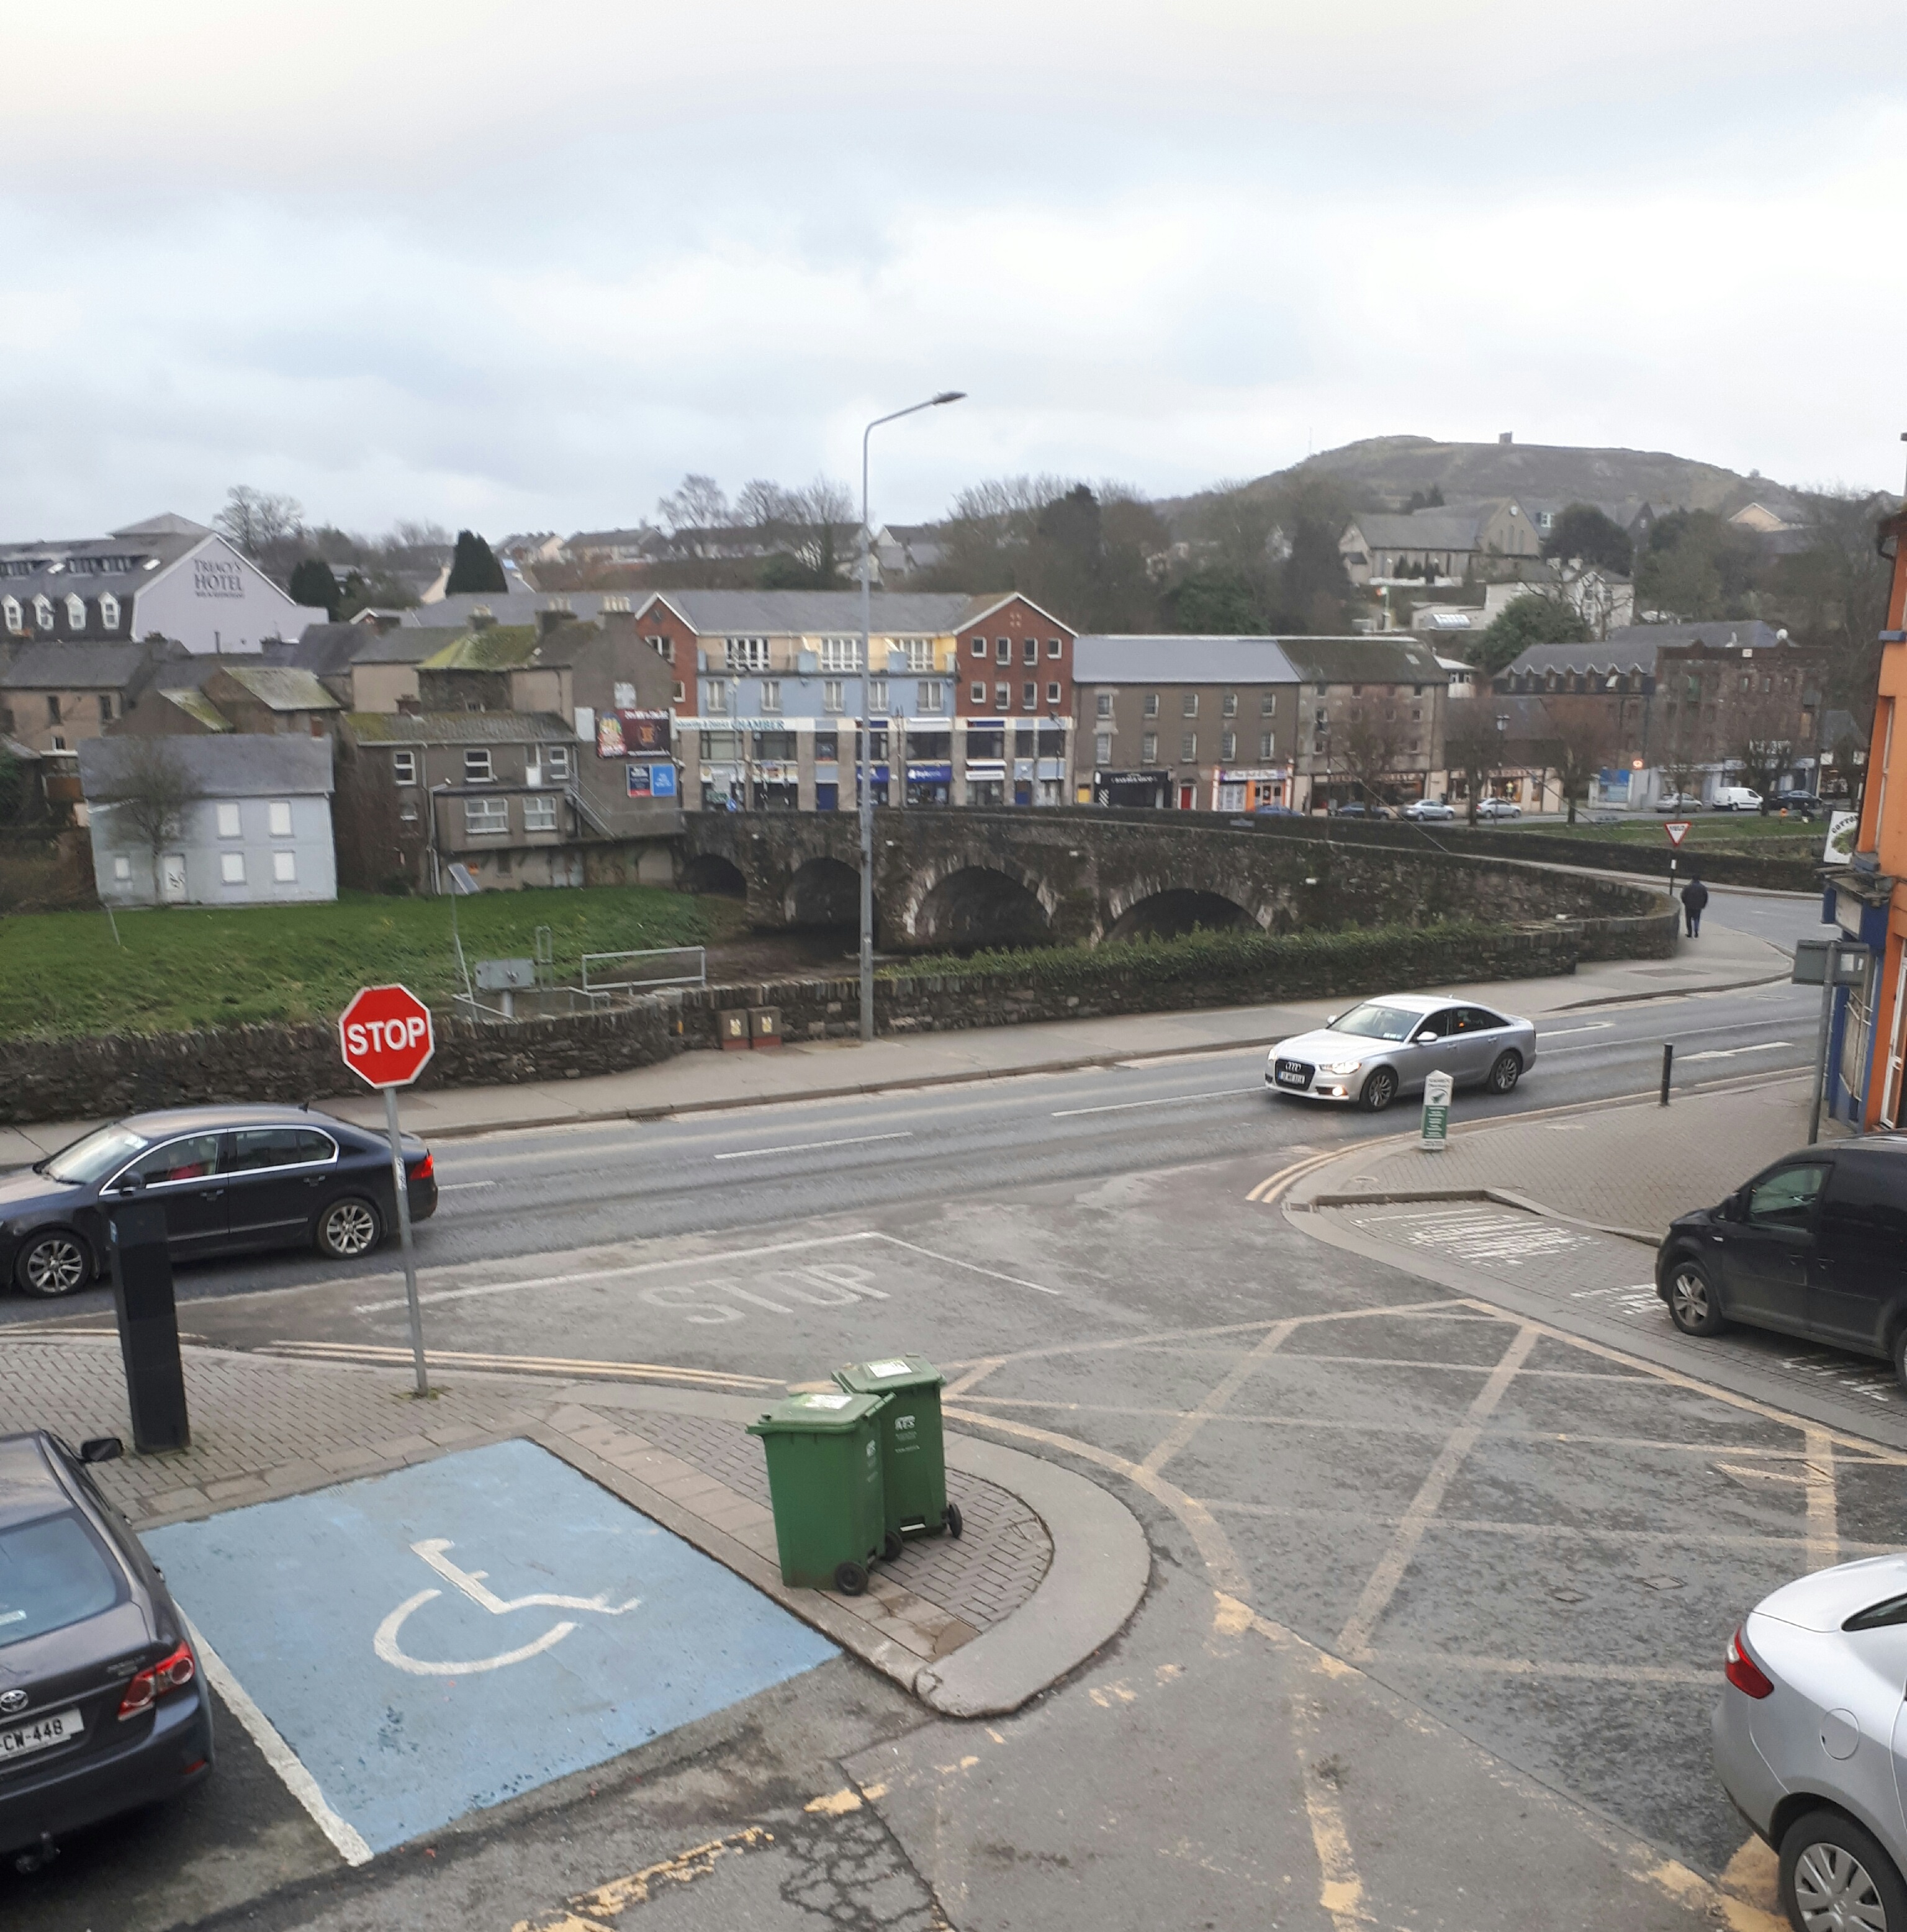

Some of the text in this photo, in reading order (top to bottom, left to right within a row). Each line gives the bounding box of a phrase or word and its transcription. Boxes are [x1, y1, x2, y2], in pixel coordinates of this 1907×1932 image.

[194, 573, 242, 590] HOTEL
[346, 1016, 427, 1055] STOP
[638, 1263, 891, 1324] STOP
